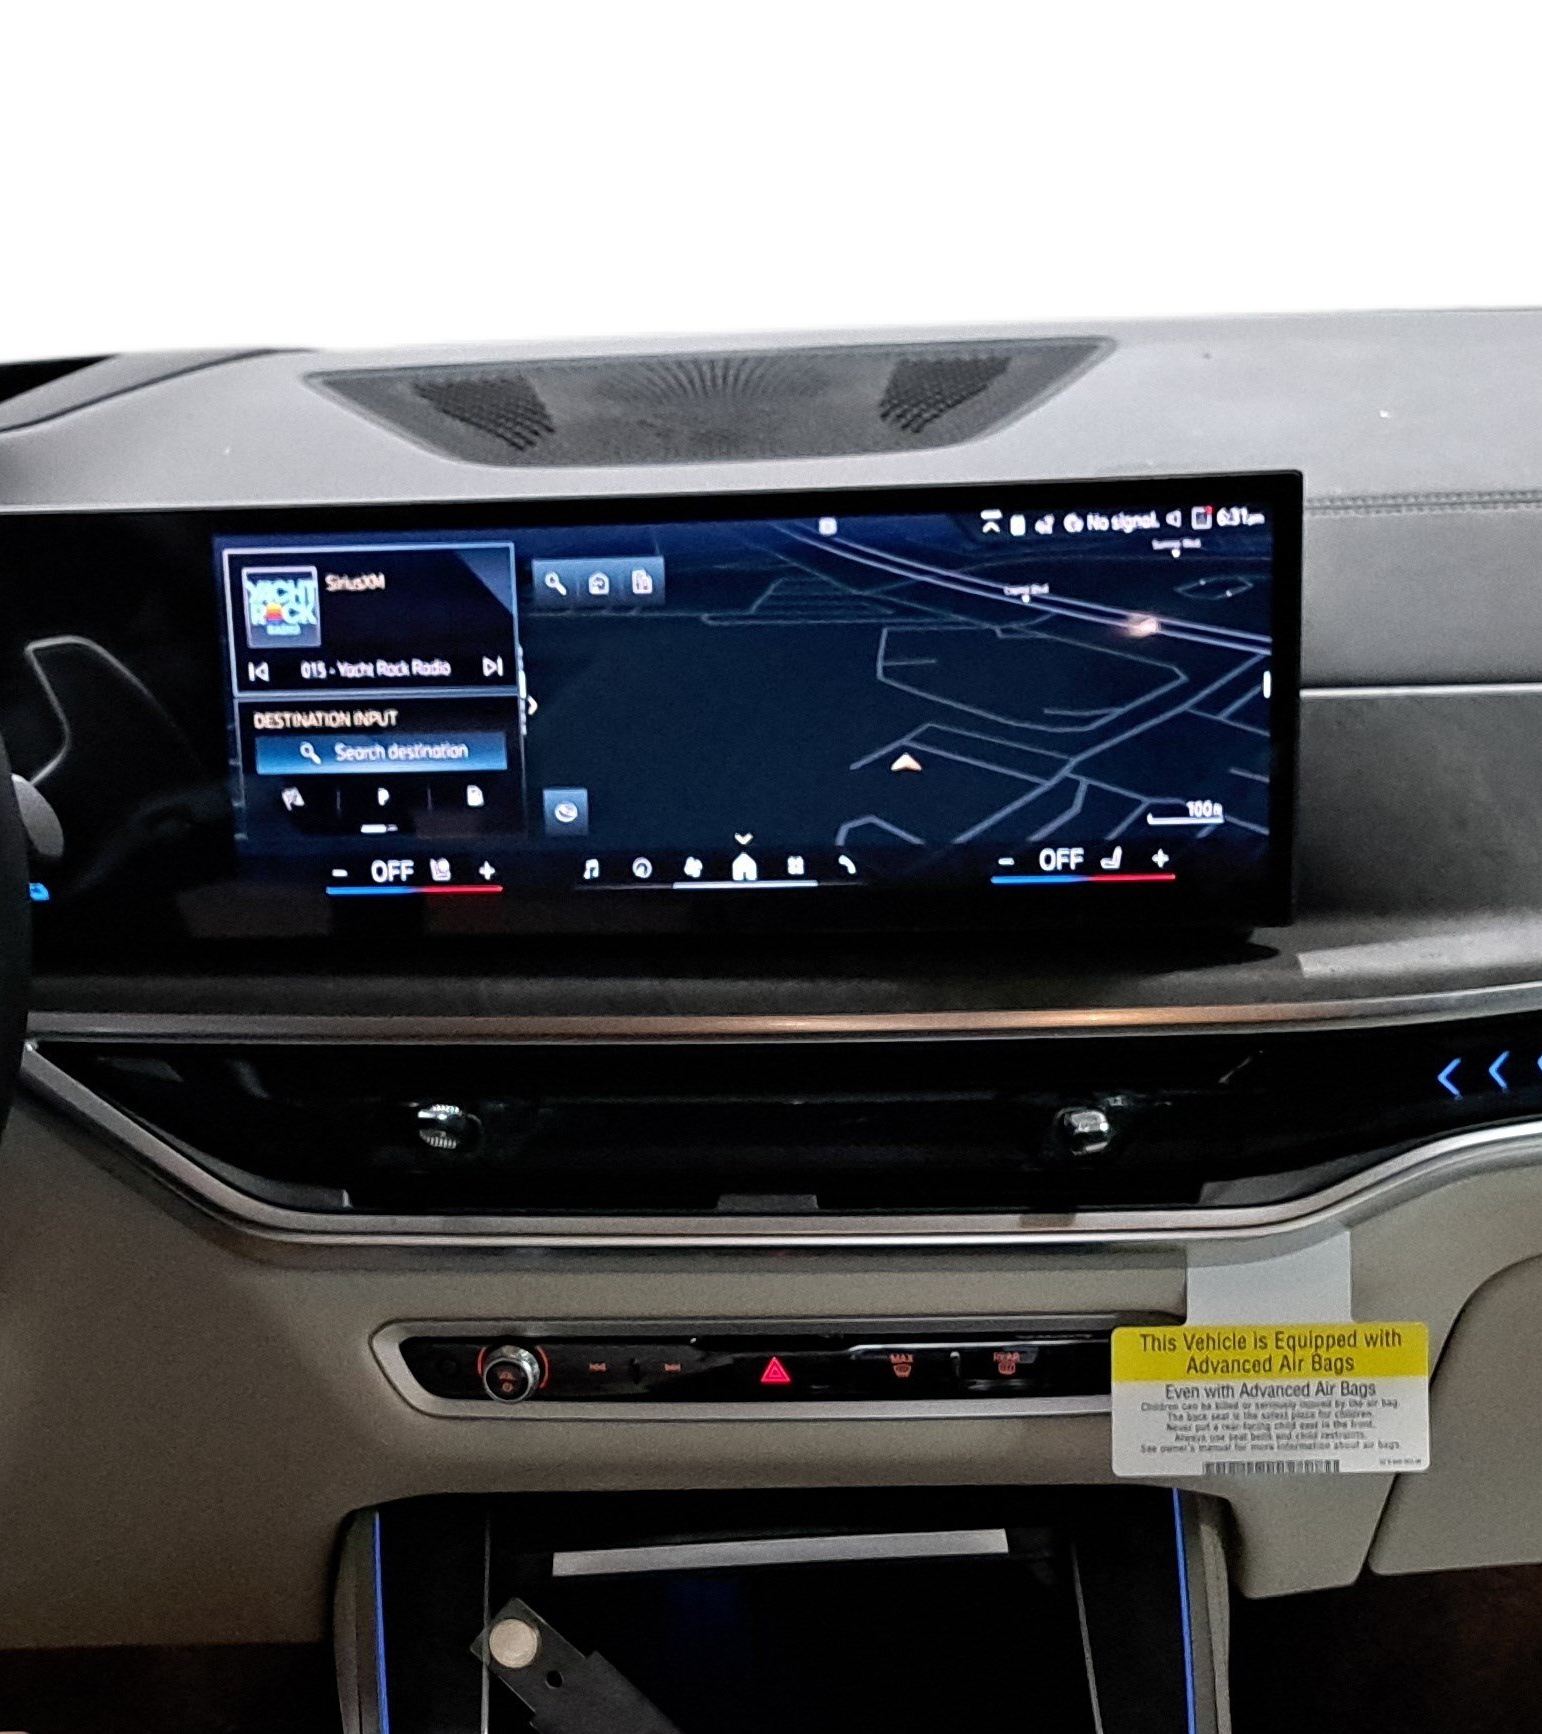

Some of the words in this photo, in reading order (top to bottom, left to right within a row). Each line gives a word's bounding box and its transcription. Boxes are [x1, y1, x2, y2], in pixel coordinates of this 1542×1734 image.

[376, 659, 410, 676] Rock
[412, 658, 451, 676] Radio
[253, 711, 351, 729] DESTINATION
[354, 709, 398, 727] INPUT
[334, 742, 385, 762] Search
[388, 741, 468, 760] destination
[1039, 848, 1084, 870] OFF
[371, 859, 414, 882] OFF
[1140, 1333, 1176, 1352] This
[1183, 1332, 1247, 1351] Vehicle
[1275, 1329, 1357, 1353] Equipped
[1364, 1328, 1402, 1348] with
[889, 1353, 913, 1363] MAX
[1186, 1353, 1272, 1374] Advanced
[1279, 1354, 1304, 1373] Air
[1311, 1353, 1355, 1375] Bags
[1165, 1384, 1200, 1399] Even
[1203, 1384, 1235, 1398] with
[1239, 1381, 1310, 1398] Advanced
[1315, 1381, 1335, 1396] Air
[1340, 1381, 1376, 1398] Bags
